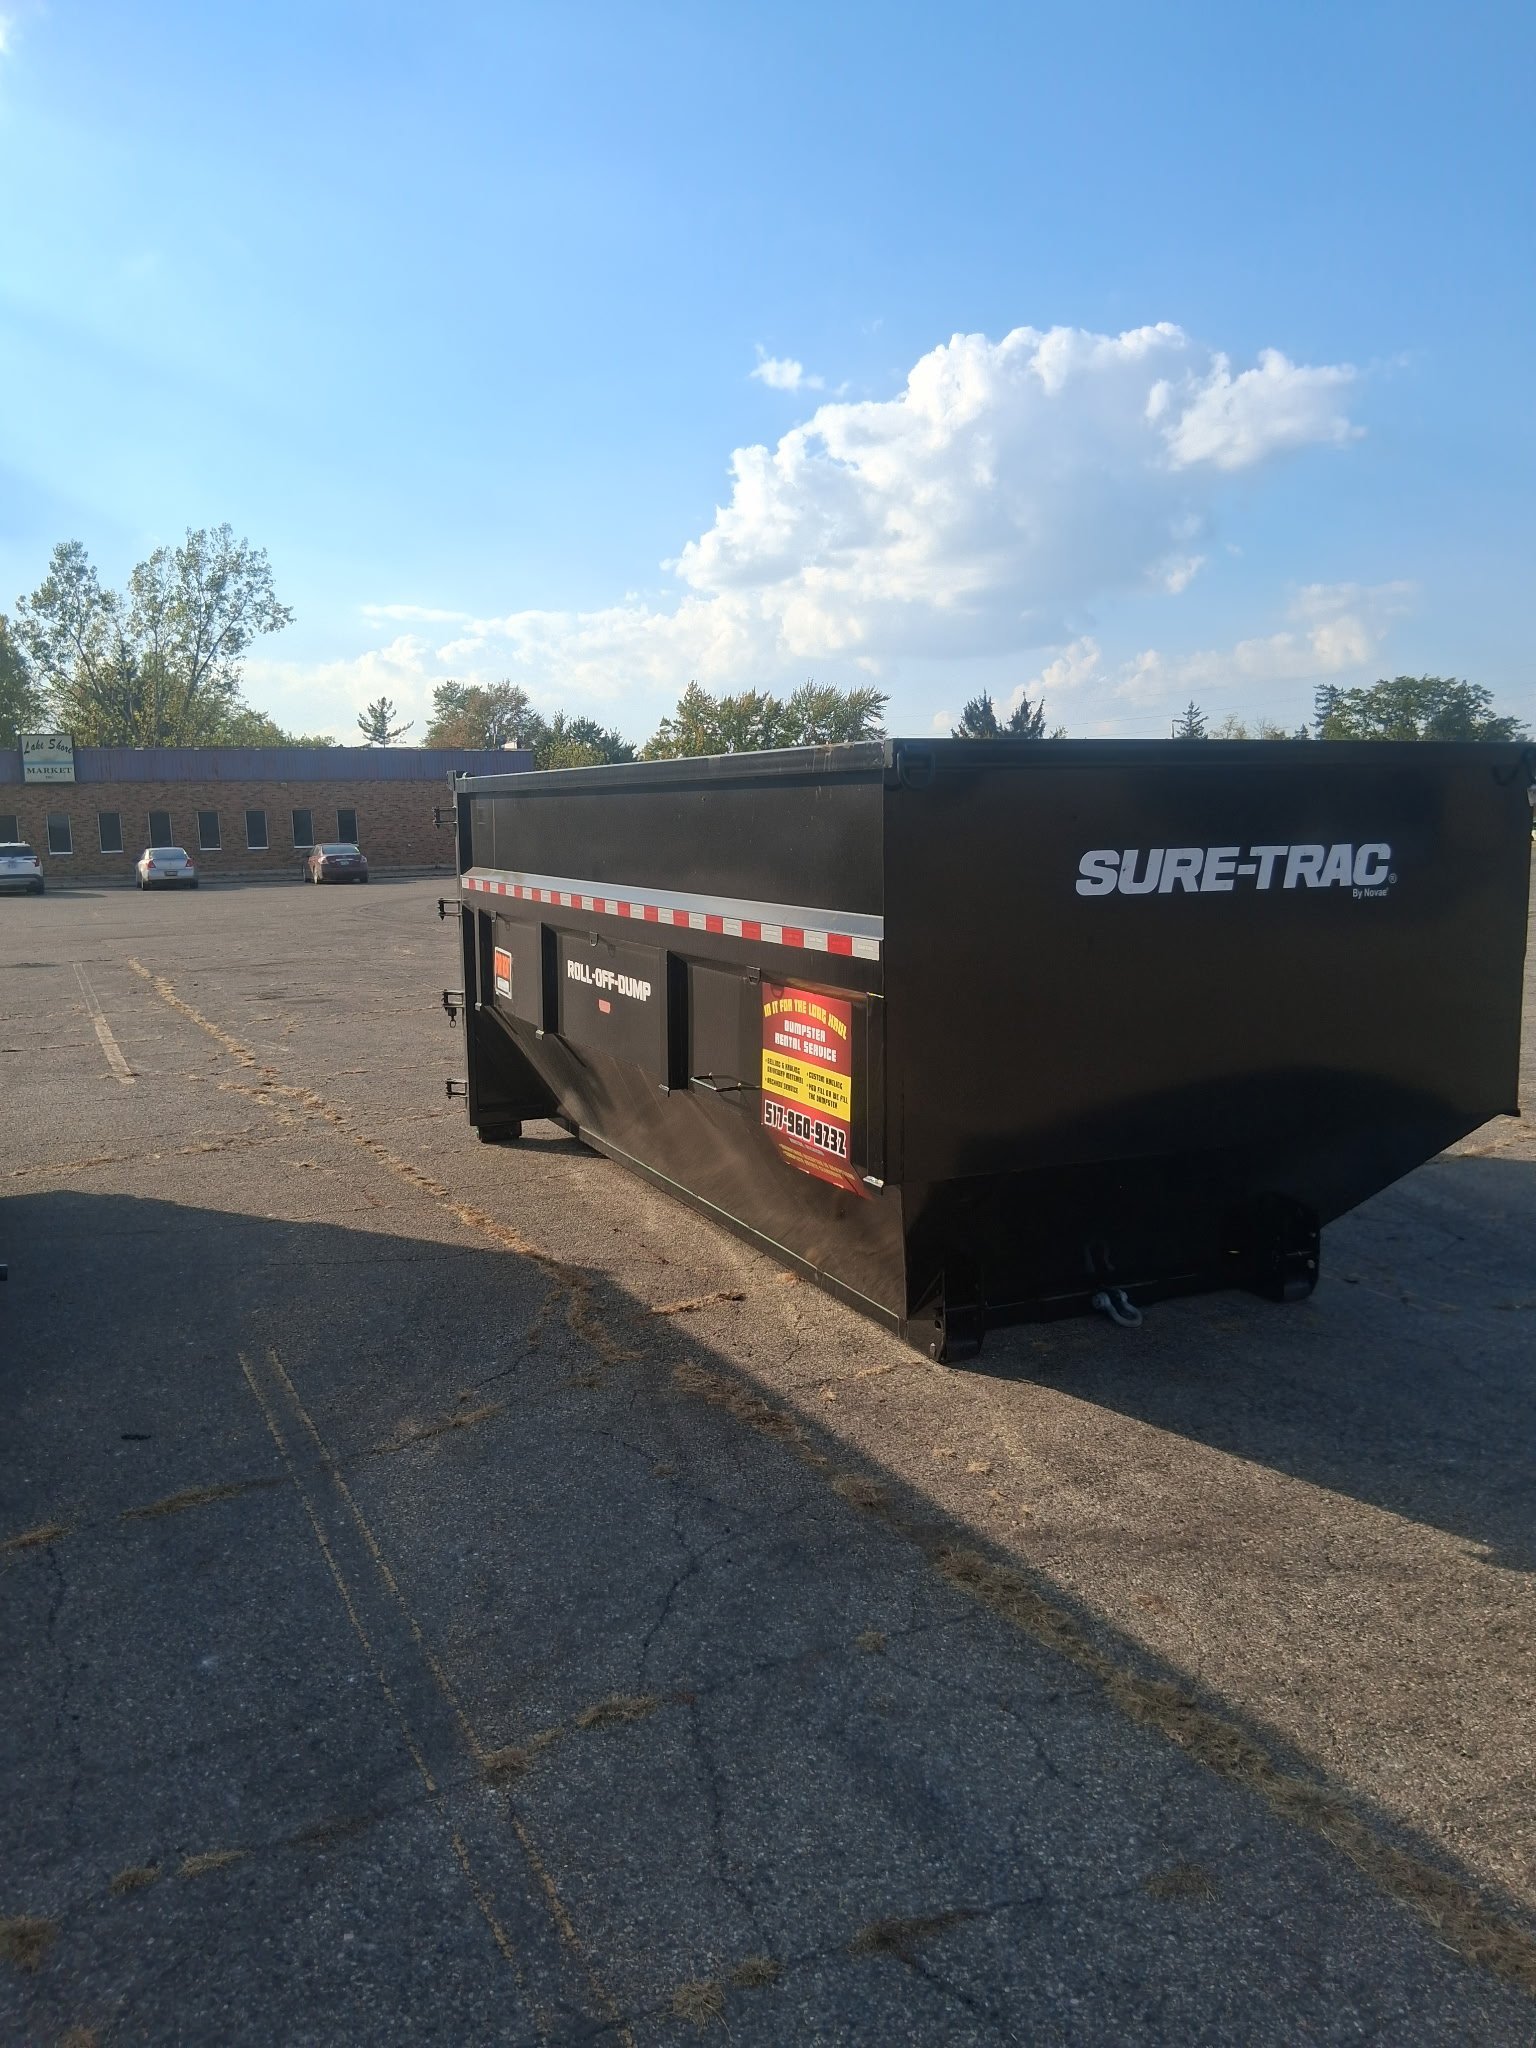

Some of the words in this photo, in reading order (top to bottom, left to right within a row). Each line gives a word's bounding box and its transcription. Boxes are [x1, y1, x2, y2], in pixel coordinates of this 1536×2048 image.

[24, 740, 44, 754] Lake
[48, 739, 73, 753] Shore
[1075, 843, 1391, 896] SURE-TRAC
[1352, 888, 1362, 899] By
[1364, 888, 1388, 897] Novae
[567, 959, 651, 1002] ROLL-OFF-DUMP
[763, 1003, 772, 1018] IN
[771, 1000, 778, 1015] IT
[779, 998, 793, 1012] FOR
[793, 998, 807, 1015] THE
[808, 1002, 827, 1025] LONG
[828, 1013, 847, 1041] HAUL
[784, 1019, 826, 1043] DUMPSTER
[774, 1032, 801, 1051] RENTAL
[803, 1040, 837, 1063] SERVICE
[783, 1082, 799, 1094] SERVICE
[808, 1071, 825, 1084] CUSTOM
[816, 1094, 838, 1109] DUMPSTER
[817, 1086, 825, 1096] FILL
[825, 1089, 832, 1098] OR
[832, 1091, 840, 1101] WE
[839, 1094, 849, 1104] FILL
[764, 1099, 847, 1159] 517-960-9232
